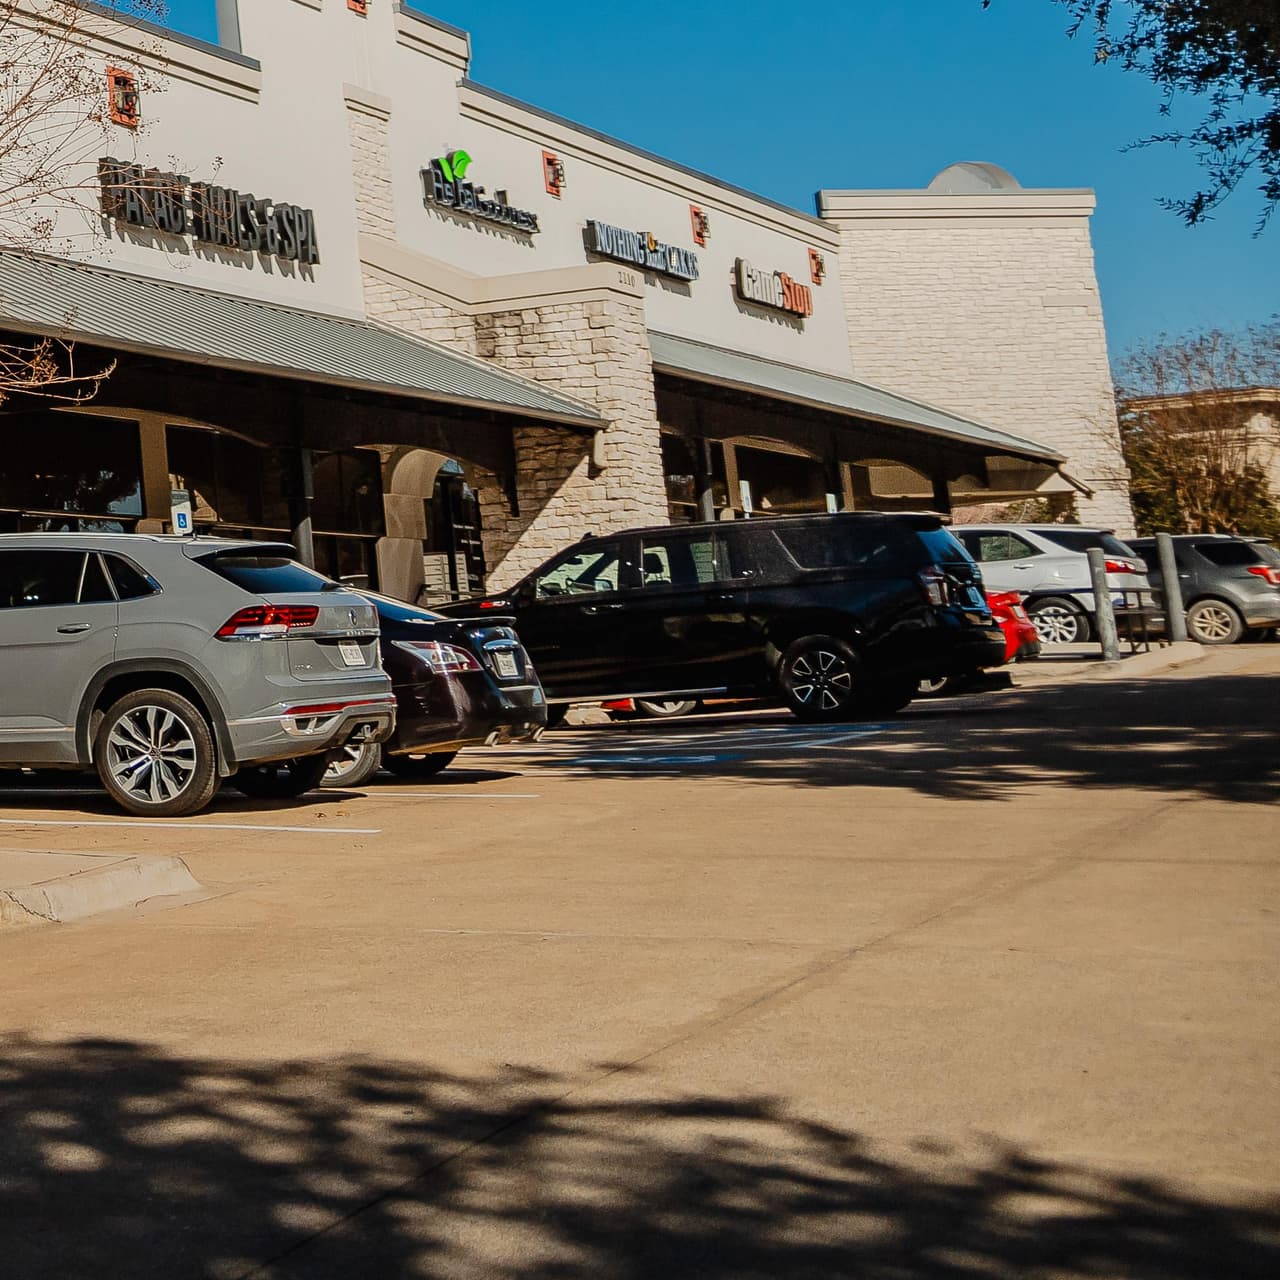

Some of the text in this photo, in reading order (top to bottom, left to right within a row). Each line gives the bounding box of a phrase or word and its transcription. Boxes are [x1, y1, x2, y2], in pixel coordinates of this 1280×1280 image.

[276, 203, 321, 265] SPA
[594, 221, 646, 266] NOTHING
[740, 259, 813, 317] GameStop
